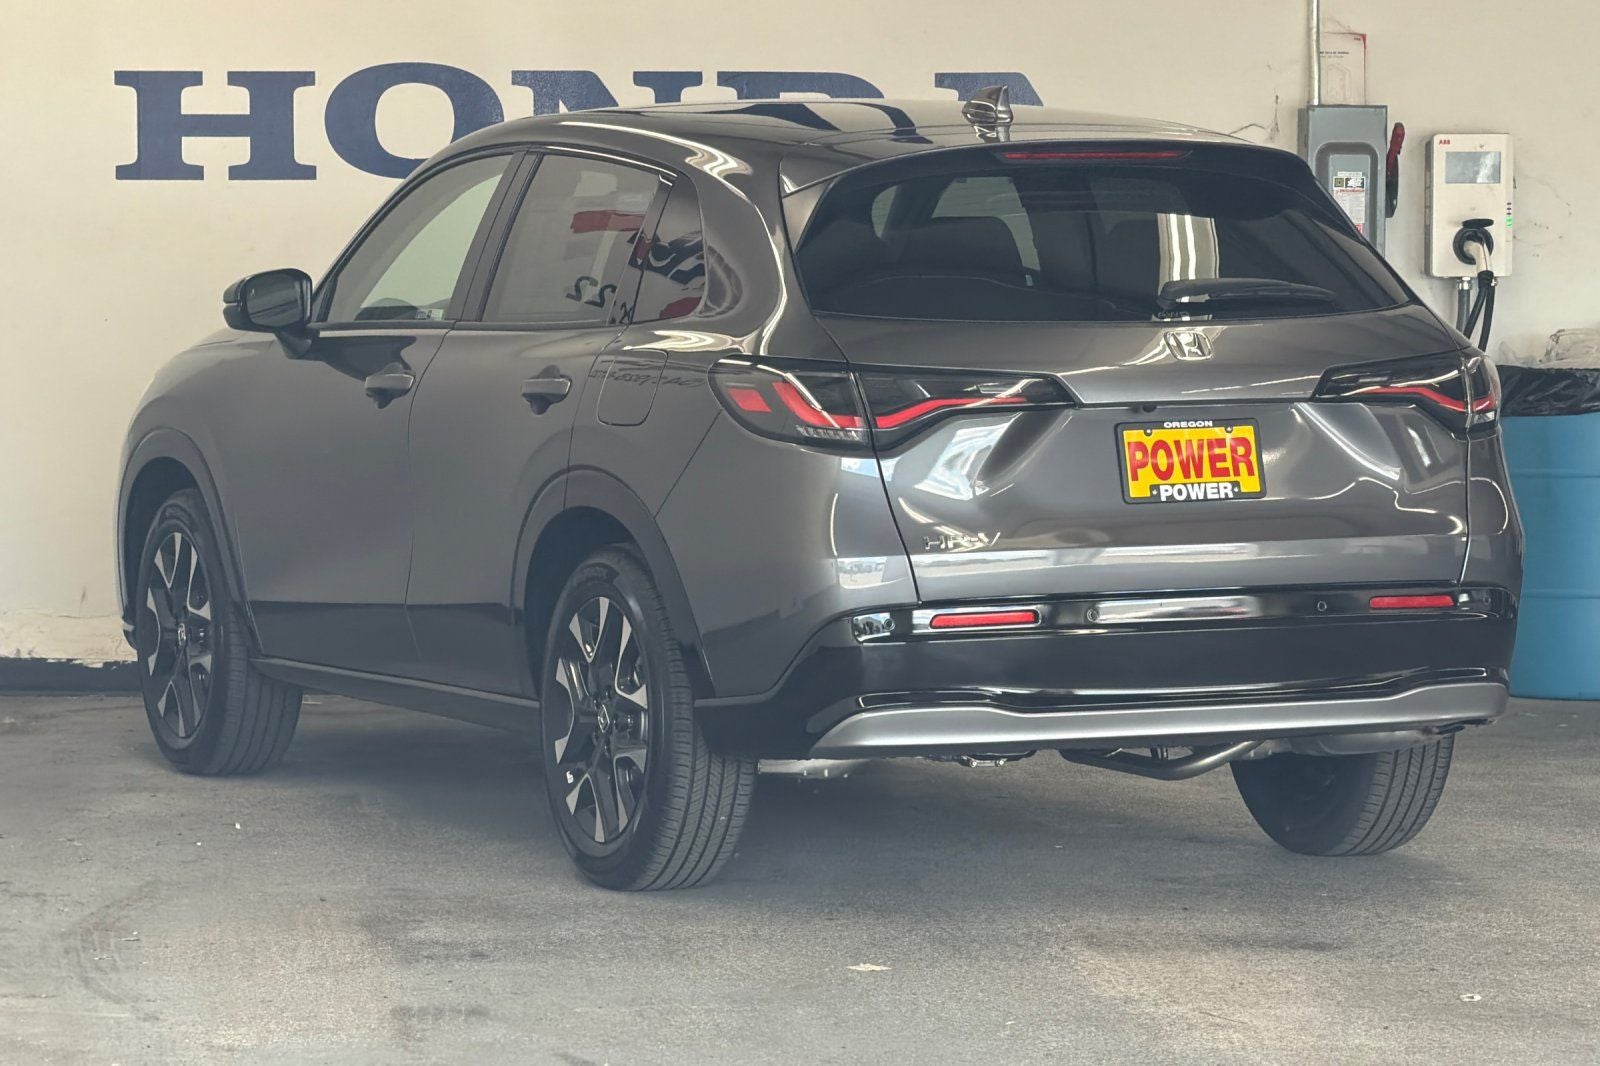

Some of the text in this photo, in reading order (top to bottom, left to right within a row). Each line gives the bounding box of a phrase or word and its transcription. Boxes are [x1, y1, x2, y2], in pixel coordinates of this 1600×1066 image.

[1163, 420, 1213, 429] OREGON
[1127, 436, 1255, 482] POWER
[1159, 482, 1234, 501] POWER
